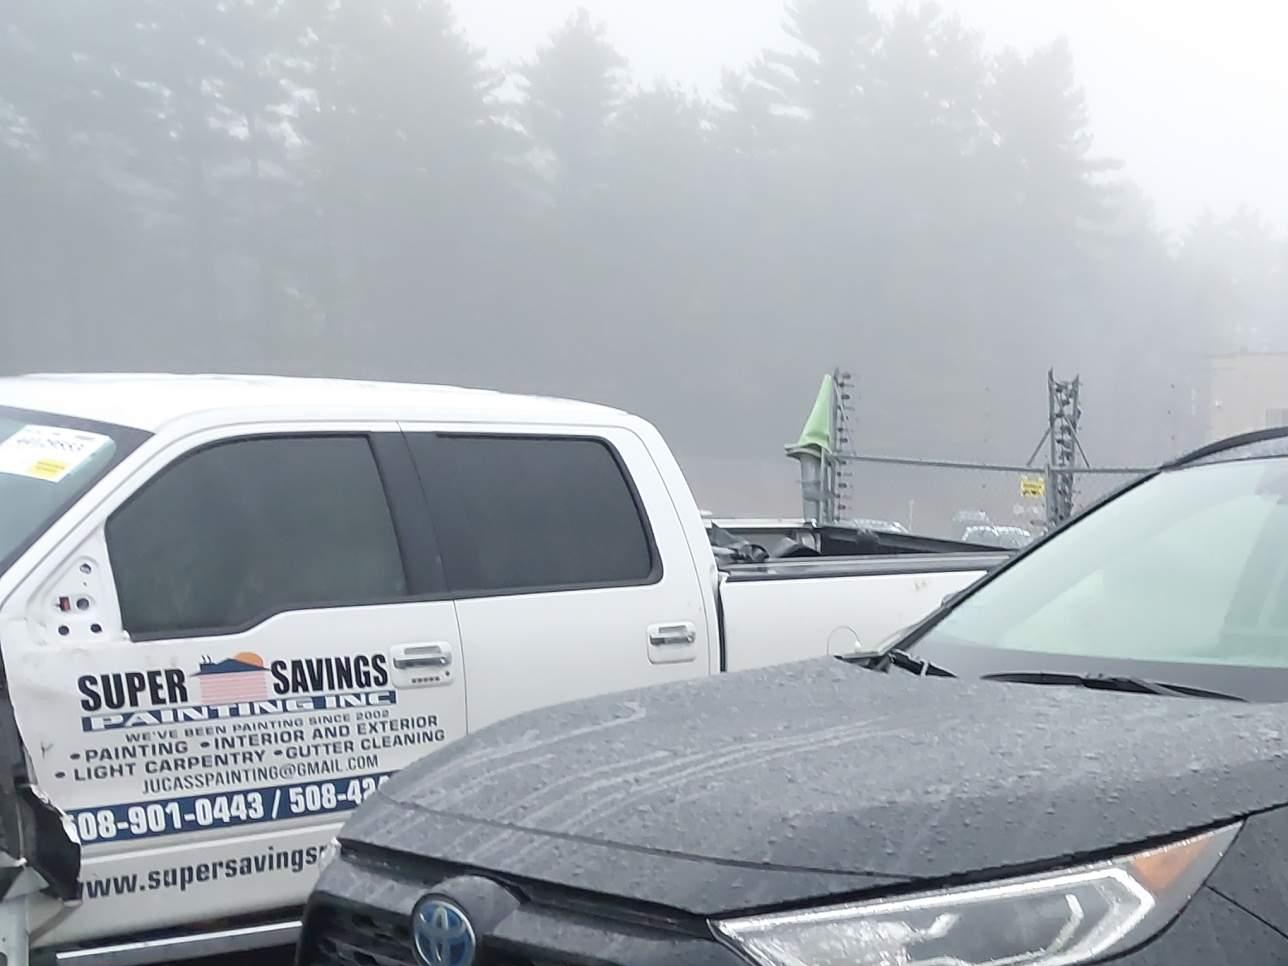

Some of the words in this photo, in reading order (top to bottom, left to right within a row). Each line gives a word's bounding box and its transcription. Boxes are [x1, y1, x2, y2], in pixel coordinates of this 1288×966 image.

[77, 668, 188, 712] SUPER
[271, 654, 388, 695] SAVINGS
[90, 698, 314, 731] PAINTING
[325, 691, 393, 709] INC
[125, 729, 178, 743] WE'VE
[185, 726, 226, 738] BEEN
[232, 718, 303, 732] PAINTING
[309, 713, 350, 726] SINCE
[356, 709, 389, 721] 2002
[74, 763, 136, 781] LIGHT
[145, 751, 265, 774] CARPENTRY
[286, 741, 354, 759] GUTTER
[361, 729, 445, 751] CLEANING
[85, 741, 188, 762] PAINTING
[214, 731, 304, 749] INTERIOR
[312, 725, 350, 740] AND
[357, 715, 438, 735] EXTERIOR
[271, 788, 281, 820] /
[80, 845, 327, 899] ww.supersavings
